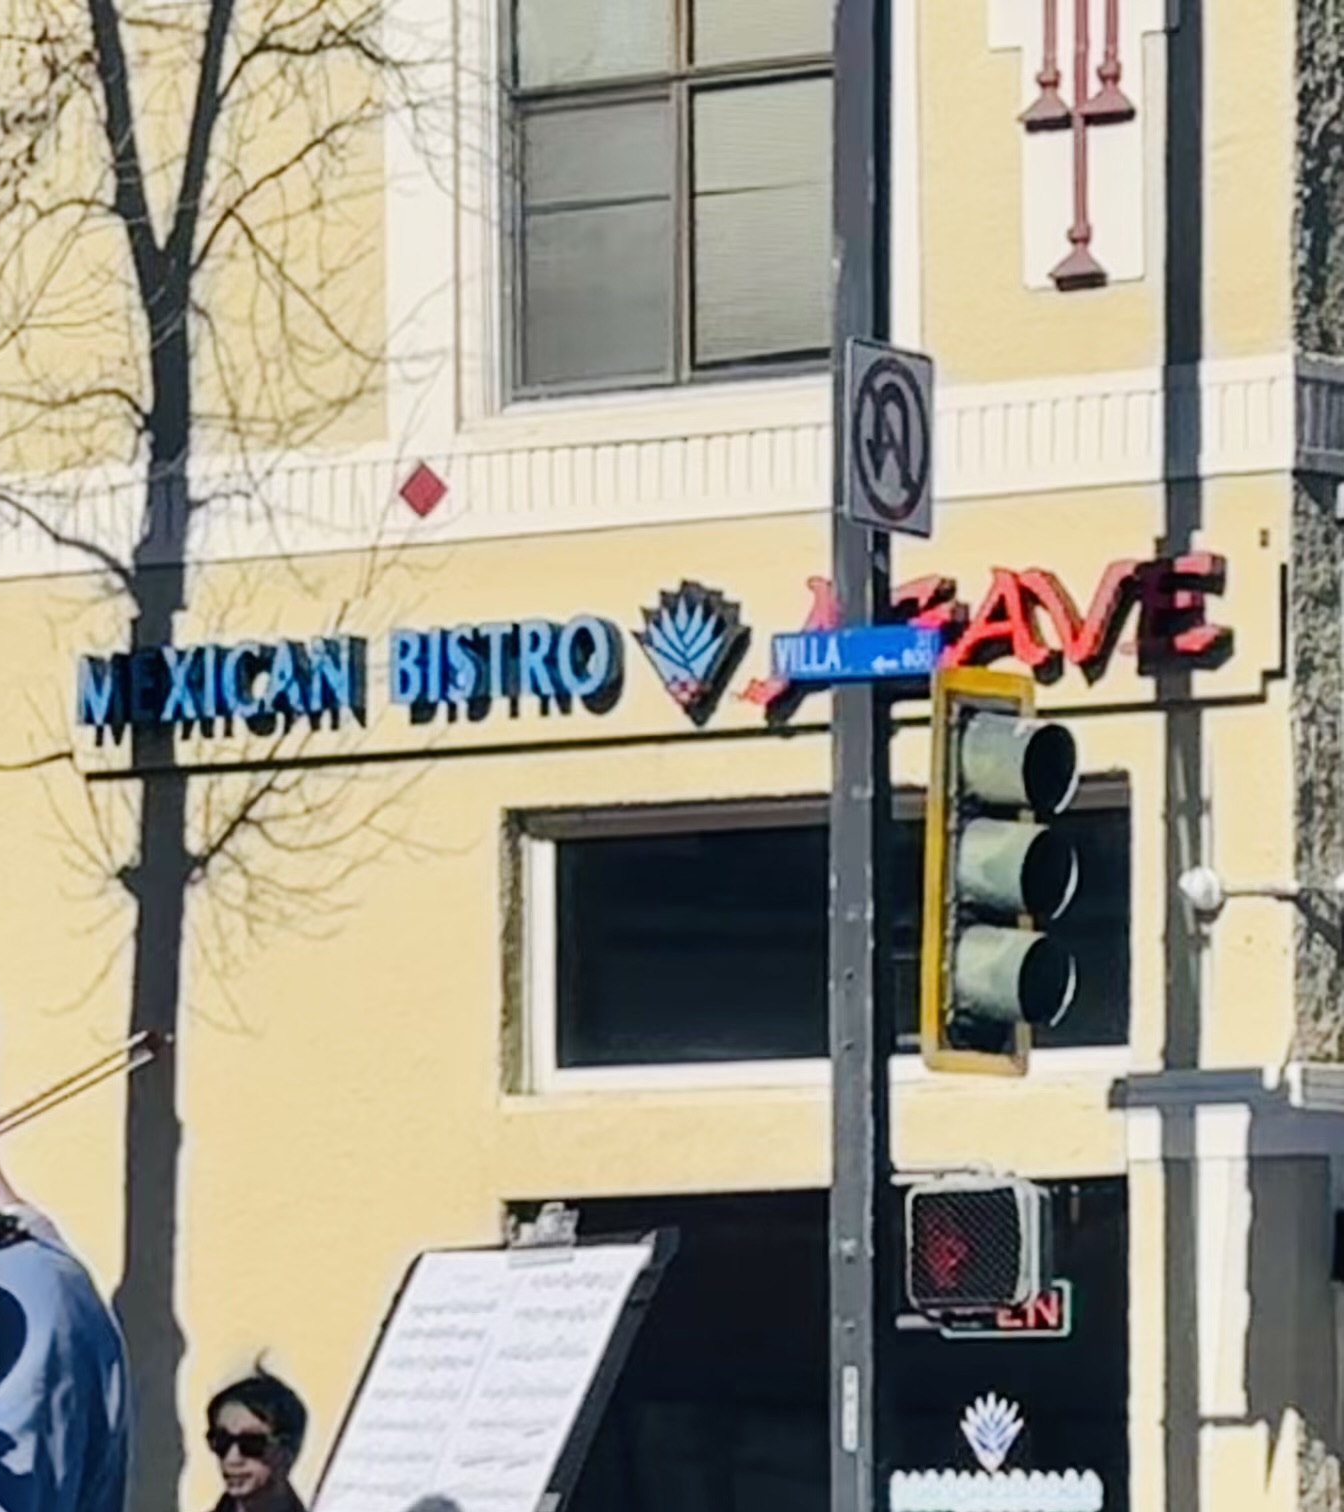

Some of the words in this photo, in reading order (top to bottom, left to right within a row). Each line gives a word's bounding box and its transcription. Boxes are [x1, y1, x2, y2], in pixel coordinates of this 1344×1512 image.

[78, 636, 362, 730] MEXICAN
[389, 615, 618, 708] BISTRO
[742, 553, 1234, 708] AVE
[773, 636, 842, 673] VILLA
